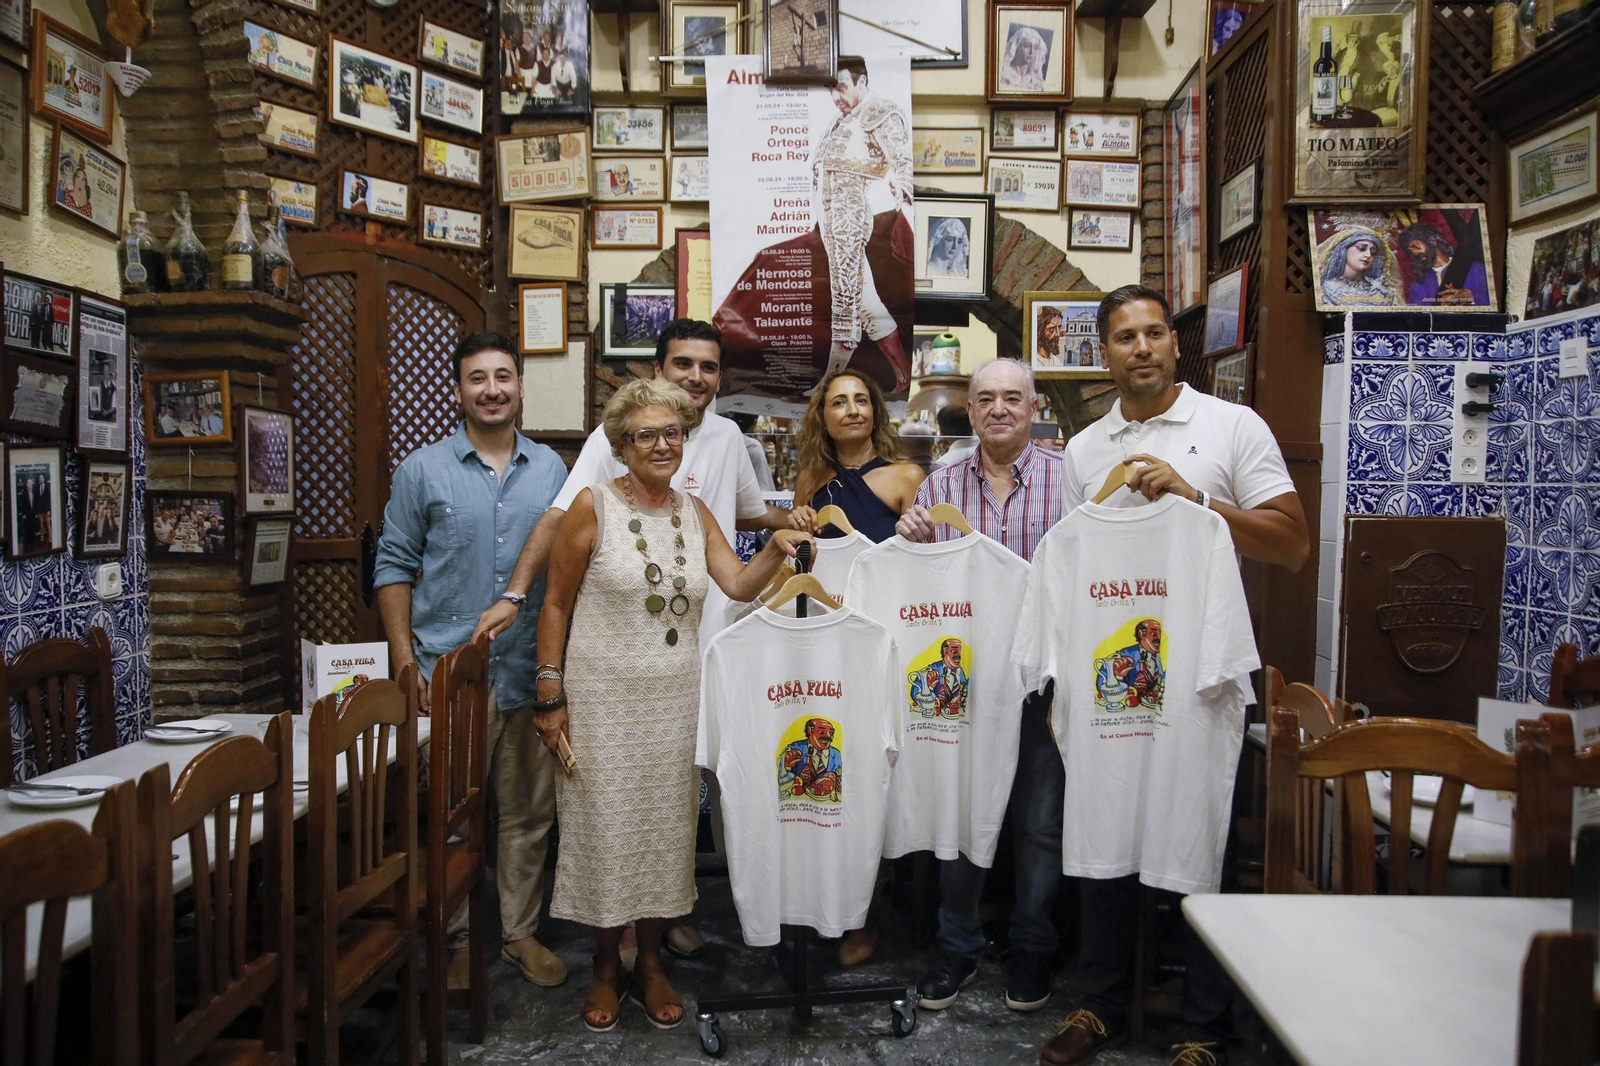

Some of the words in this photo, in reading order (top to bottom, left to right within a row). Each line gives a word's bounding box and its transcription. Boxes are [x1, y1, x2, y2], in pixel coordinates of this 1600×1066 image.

[534, 95, 553, 107] Puga
[770, 126, 809, 135] Ponce
[1022, 123, 1047, 132] 89691
[767, 138, 809, 149] Ortega
[1308, 138, 1335, 152] TIO
[1340, 137, 1399, 151] MATEO
[752, 152, 782, 162] Roca
[786, 151, 810, 162] Rey
[1328, 158, 1362, 168] Palomino
[774, 198, 810, 208] Ureña
[770, 211, 811, 222] Adrián
[534, 218, 552, 233] CASA
[756, 268, 812, 280] Hermoso
[737, 280, 752, 291] de
[756, 279, 812, 290] Mendoza
[760, 302, 813, 313] Morante
[754, 316, 813, 328] Talavante
[1090, 579, 1133, 600] CASA
[1135, 578, 1168, 599] PUGA
[900, 602, 940, 622] CASA
[331, 658, 354, 668] CASA
[354, 656, 376, 667] PUGA
[768, 680, 804, 702] CASA
[806, 680, 842, 699] PUGA
